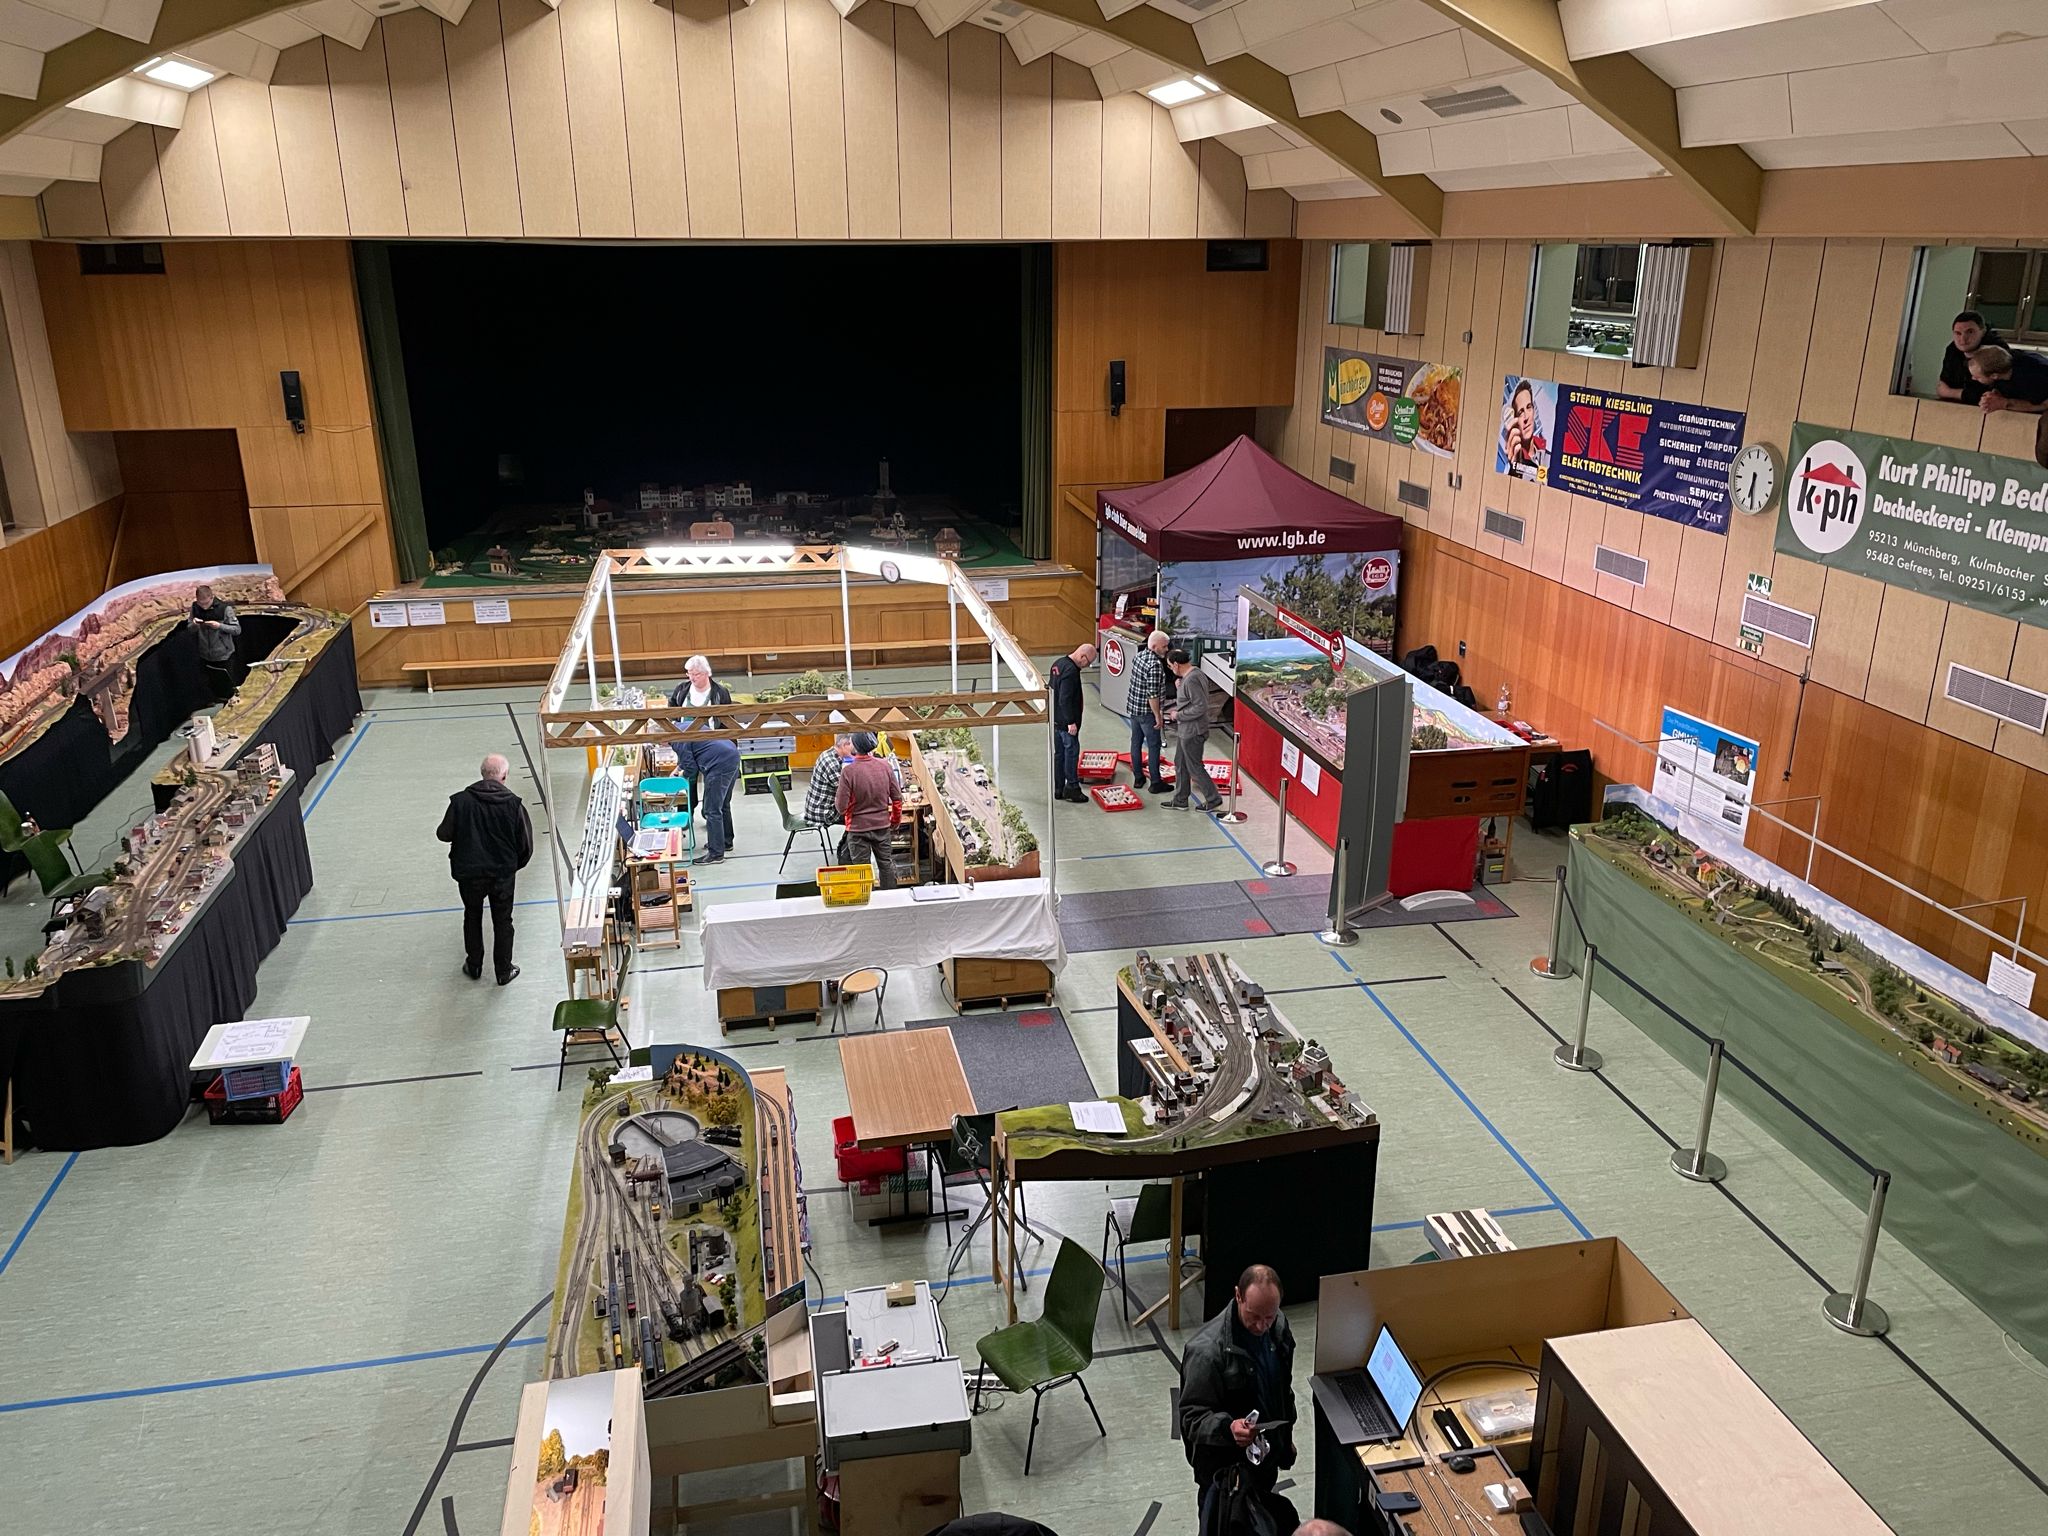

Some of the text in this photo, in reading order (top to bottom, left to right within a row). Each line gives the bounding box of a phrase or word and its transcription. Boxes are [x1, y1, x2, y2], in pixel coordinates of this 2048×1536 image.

[1570, 392, 1653, 415] STEFAN KIESSLING
[1659, 421, 1712, 437] AUTOMATISIERUNG
[1678, 413, 1736, 431] GEBÄUDETECHNIK
[1563, 405, 1649, 470] SKE
[1659, 438, 1738, 454] SICHERHEIT KOMFORT
[1561, 455, 1643, 485] ELEKTROTECHNIK
[1663, 454, 1691, 468] WÄRME
[1878, 455, 1919, 487] Kurt
[1921, 463, 1996, 507] Philipp
[1653, 489, 1704, 509] PHOTOVOLTAIK
[1689, 487, 1724, 502] SERVICE
[1697, 510, 1723, 524] LICHT
[1872, 493, 1973, 534] Dachdeckerei
[1237, 530, 1326, 550] www.lgb.de
[1868, 530, 1898, 548] 95213
[1904, 539, 1961, 566] Münchberg,
[1969, 555, 2036, 583] Kulmbacher
[1866, 548, 1895, 566] 95482
[1896, 556, 1936, 580] Gefrees,
[1938, 568, 1955, 583] Tel.
[1958, 573, 2026, 602] 09251/6153
